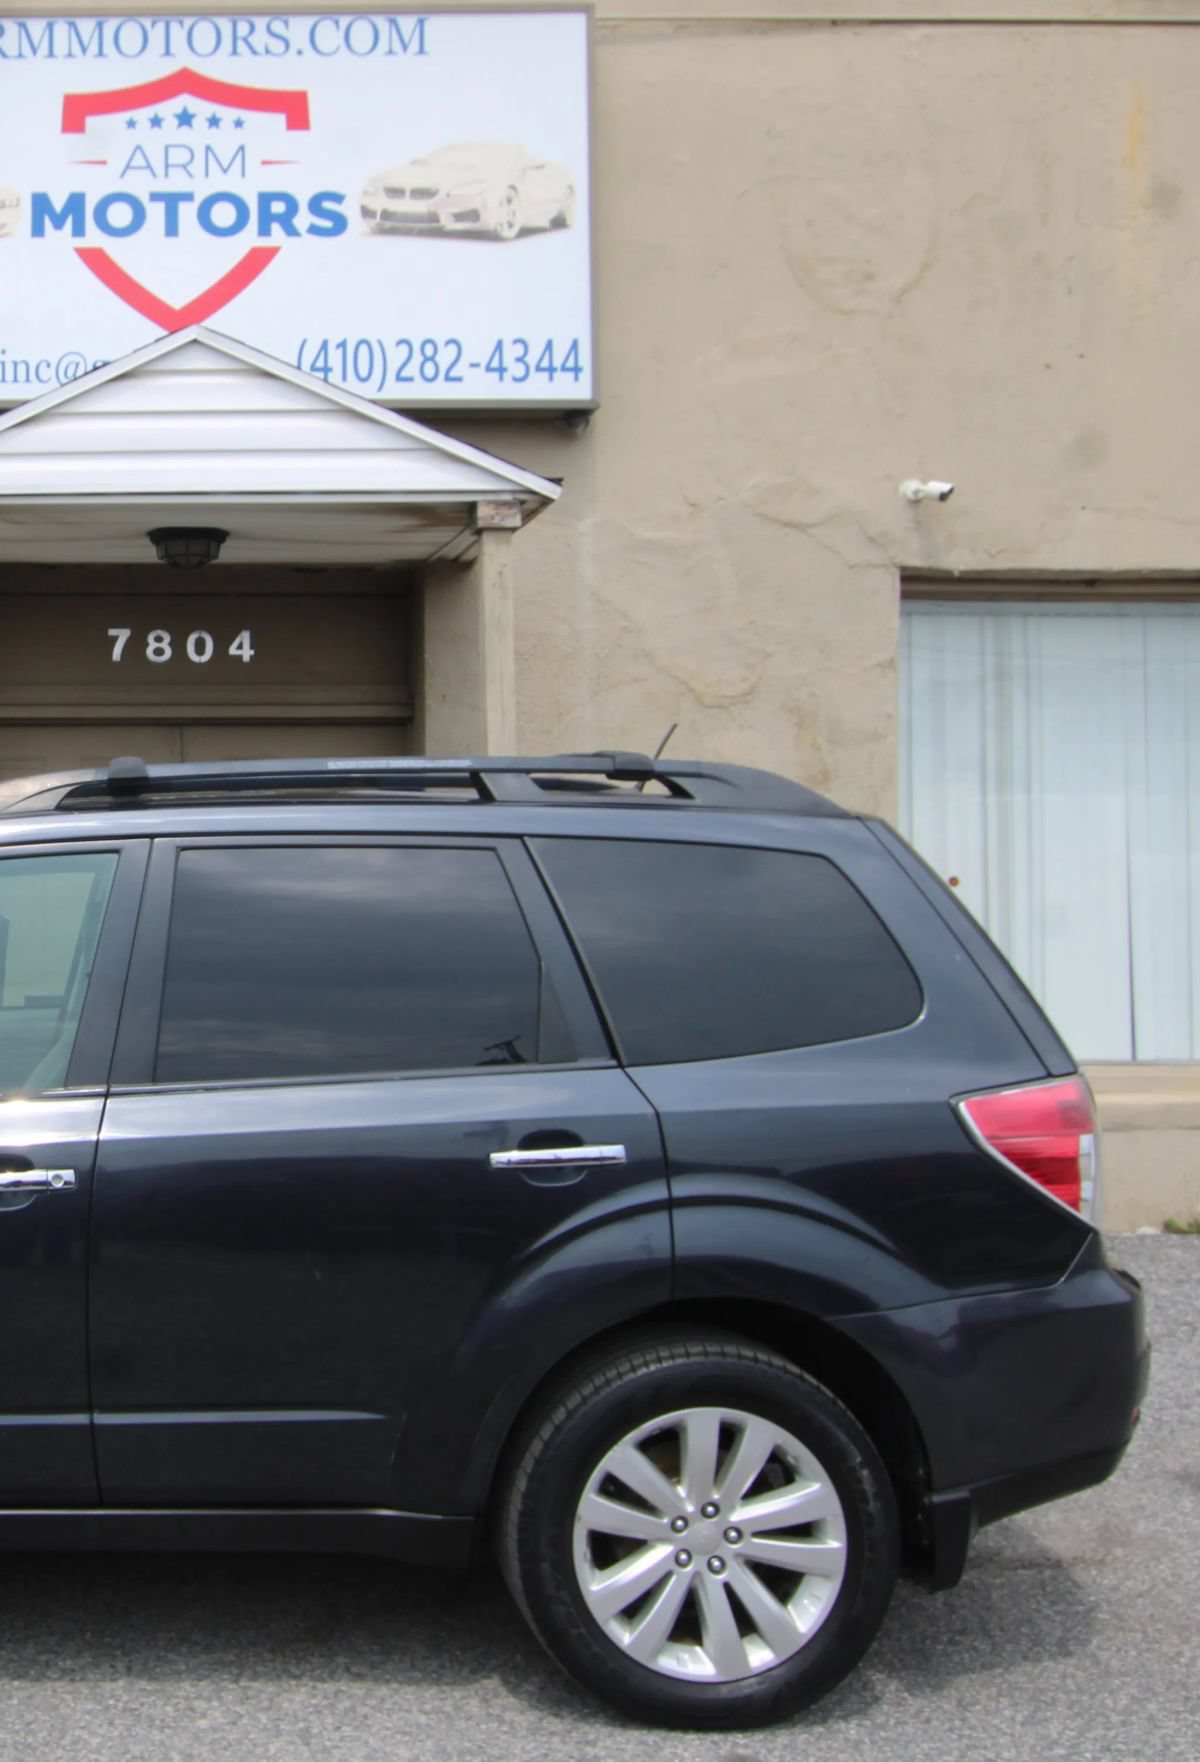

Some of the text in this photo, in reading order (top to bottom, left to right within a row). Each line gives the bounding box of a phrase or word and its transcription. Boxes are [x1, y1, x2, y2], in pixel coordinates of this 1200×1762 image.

[119, 143, 247, 179] ARM
[29, 190, 349, 239] MOTORS
[107, 628, 255, 663] 7804
